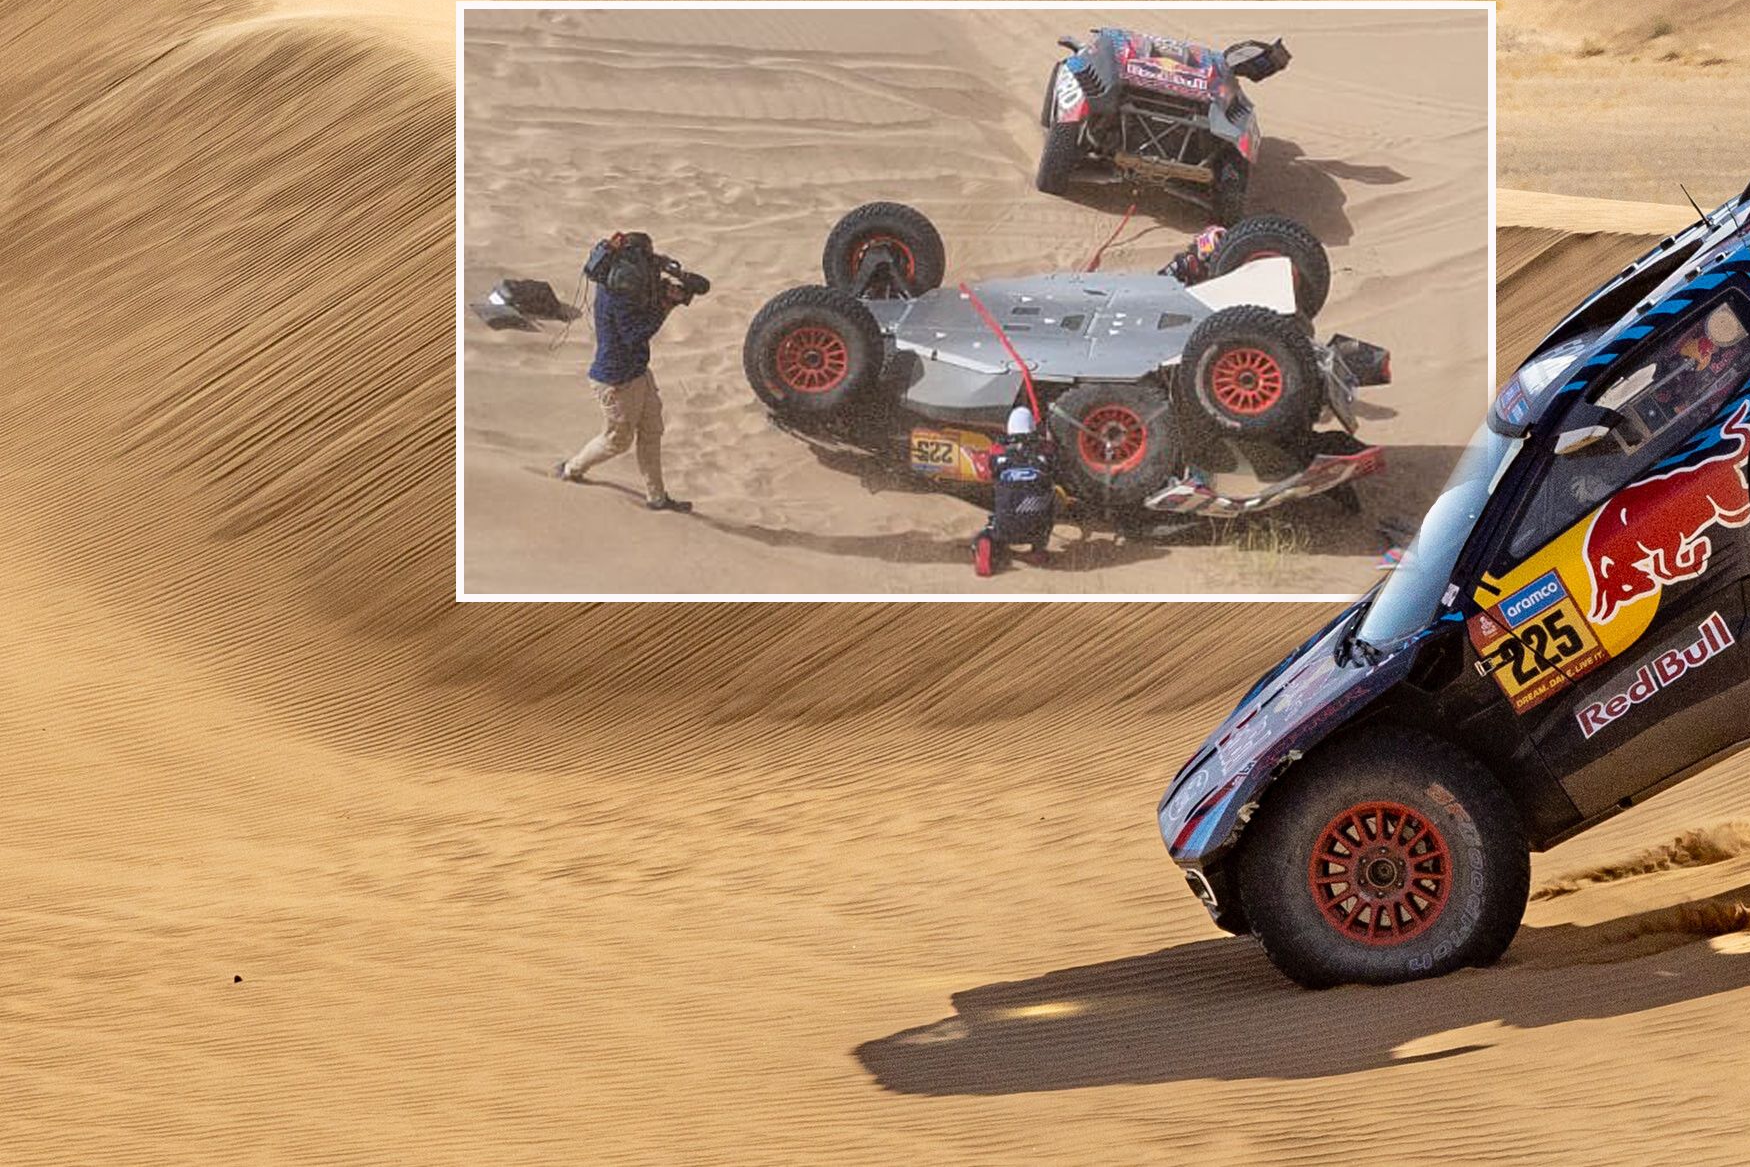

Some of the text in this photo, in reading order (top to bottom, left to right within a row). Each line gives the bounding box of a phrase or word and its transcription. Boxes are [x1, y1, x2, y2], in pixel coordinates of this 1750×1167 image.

[1507, 582, 1558, 618] aramco
[1498, 609, 1584, 686] 225
[1576, 611, 1735, 739] Red Bull
